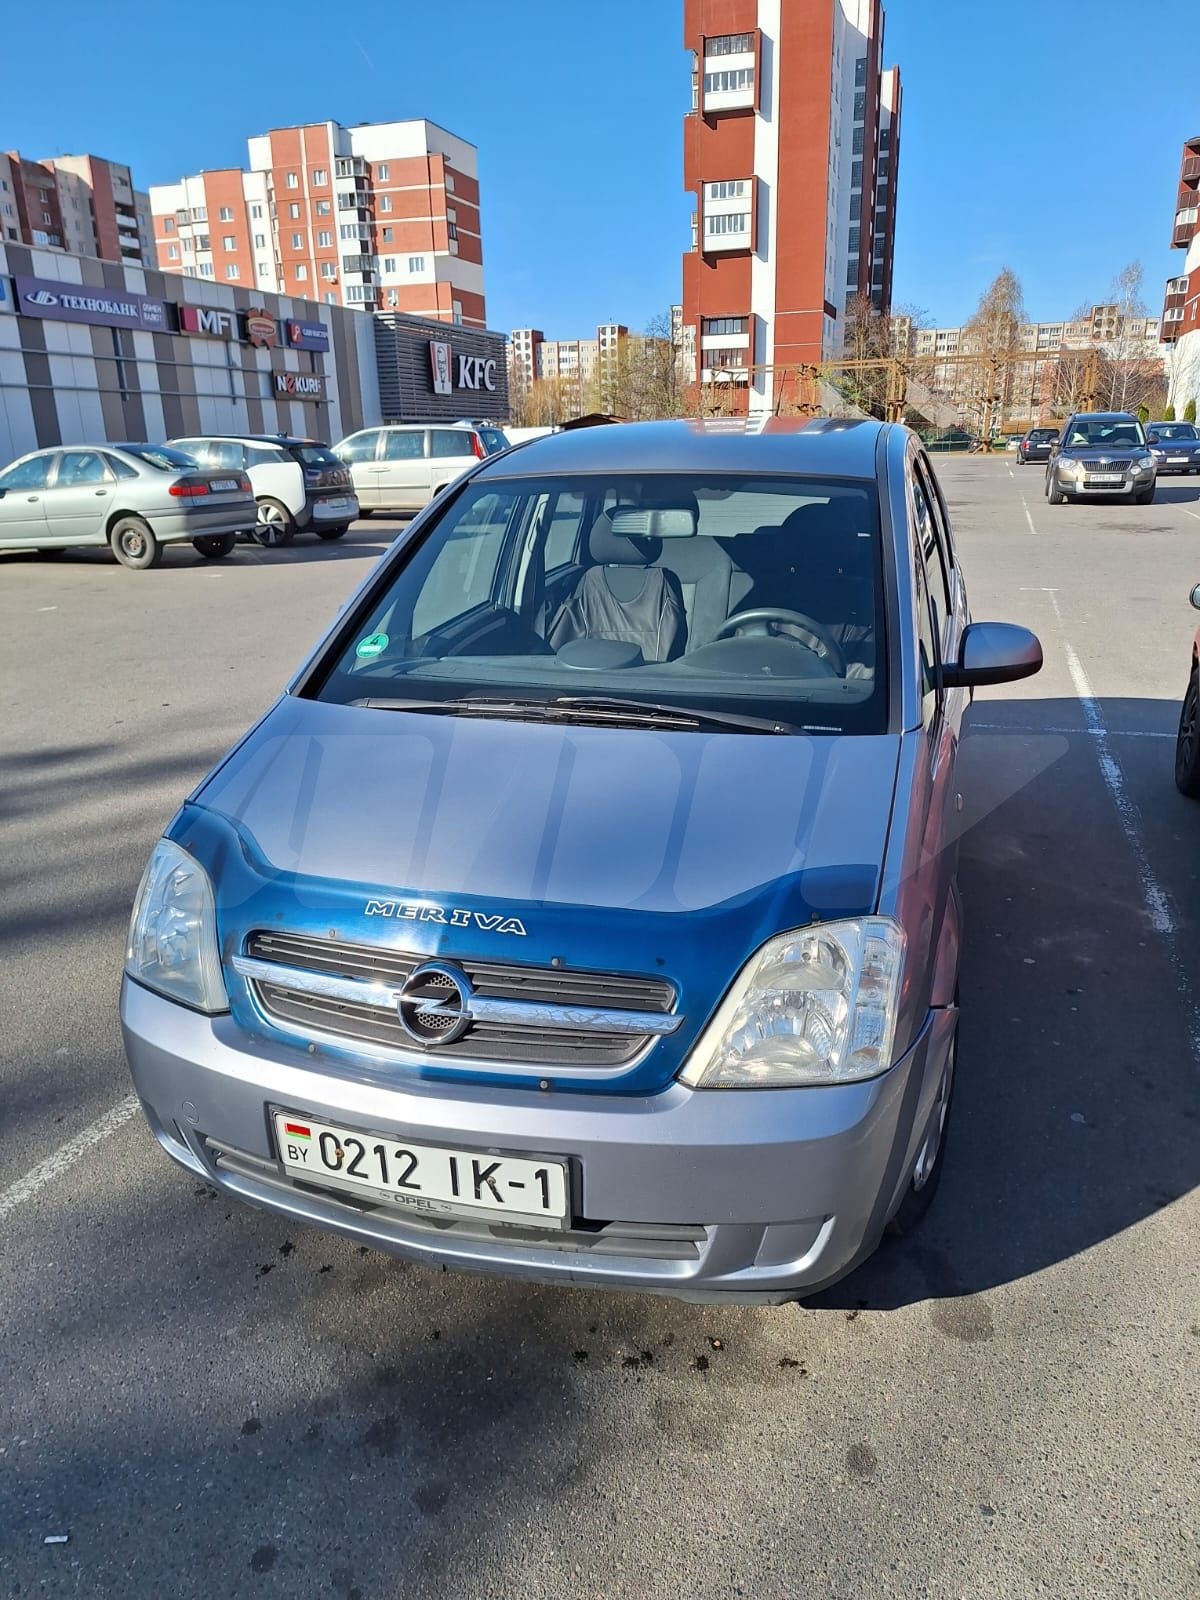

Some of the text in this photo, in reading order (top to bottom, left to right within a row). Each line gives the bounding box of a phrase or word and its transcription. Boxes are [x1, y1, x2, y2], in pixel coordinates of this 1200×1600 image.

[60, 294, 139, 317] ТЕХНОБАНК
[458, 355, 497, 391] KFC
[364, 900, 527, 936] MERIVA
[287, 1144, 309, 1163] BY
[318, 1131, 550, 1209] 0212 IK-1
[394, 1194, 437, 1210] OPEL
